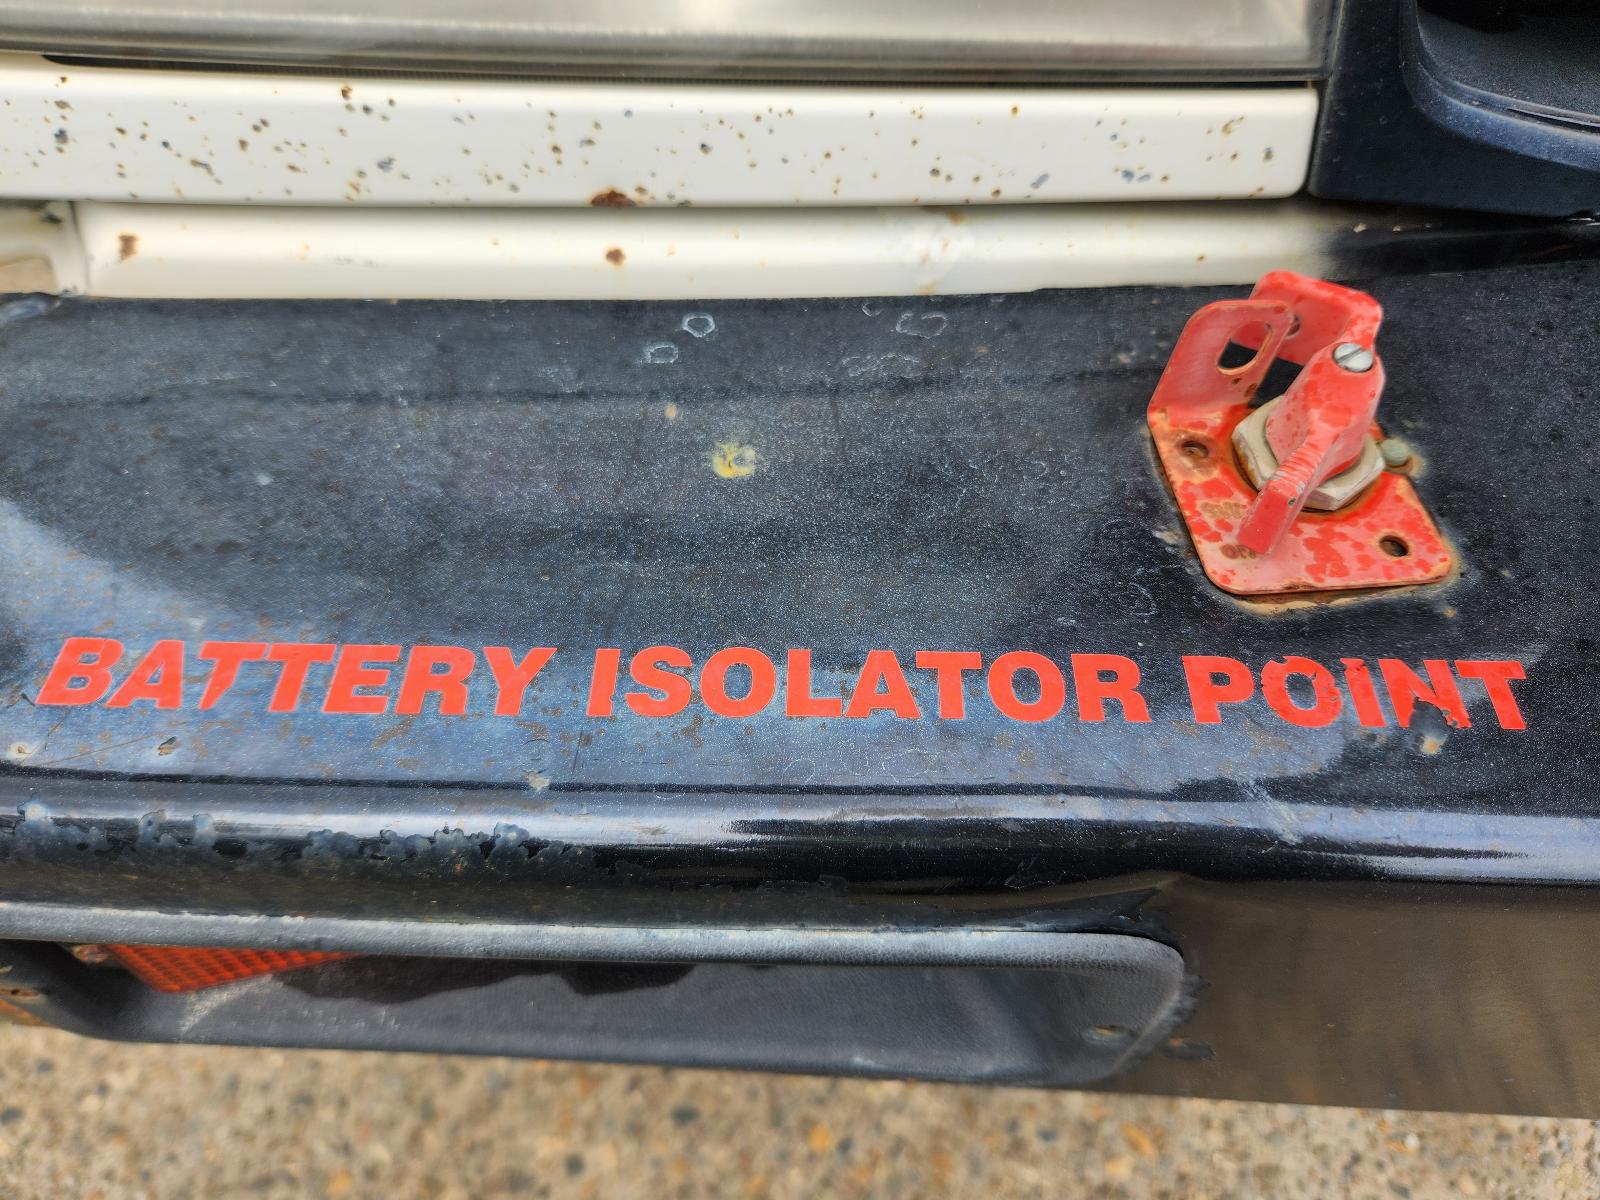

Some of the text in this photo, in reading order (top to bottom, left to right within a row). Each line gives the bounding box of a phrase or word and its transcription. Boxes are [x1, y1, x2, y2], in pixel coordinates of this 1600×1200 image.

[38, 637, 1527, 731] BATTERY ISOLATOR POINT
